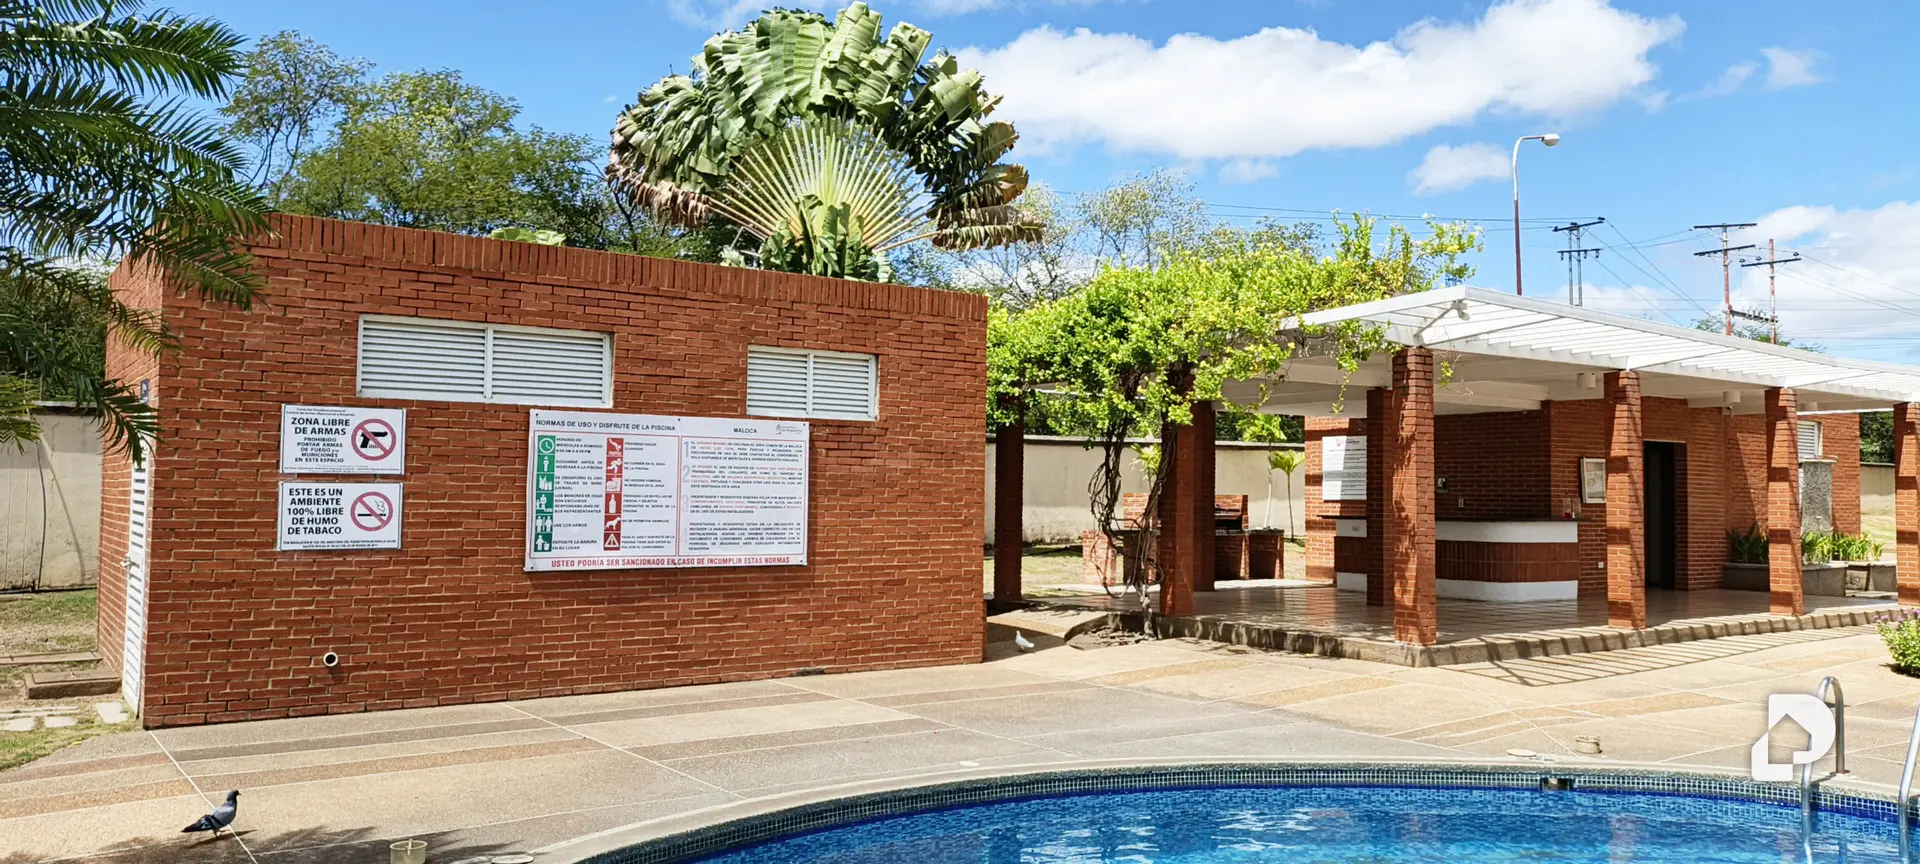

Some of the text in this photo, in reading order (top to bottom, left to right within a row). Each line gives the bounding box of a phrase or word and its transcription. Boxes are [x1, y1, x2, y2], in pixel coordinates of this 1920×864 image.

[291, 417, 350, 426] ZONA LIBRE
[536, 419, 566, 427] NORMAS
[599, 422, 630, 430] DISFRUTE
[295, 427, 346, 435] DE ARMAS
[289, 488, 343, 496] ESTE ES UN
[290, 498, 341, 506] AMBIENTE
[287, 507, 344, 515] 100% LIBRE
[292, 517, 338, 525] DE HUMO
[288, 527, 342, 535] DE TABACO
[577, 559, 603, 567] PODRÍA
[621, 558, 665, 566] SANCIONADO
[667, 558, 676, 566] EN
